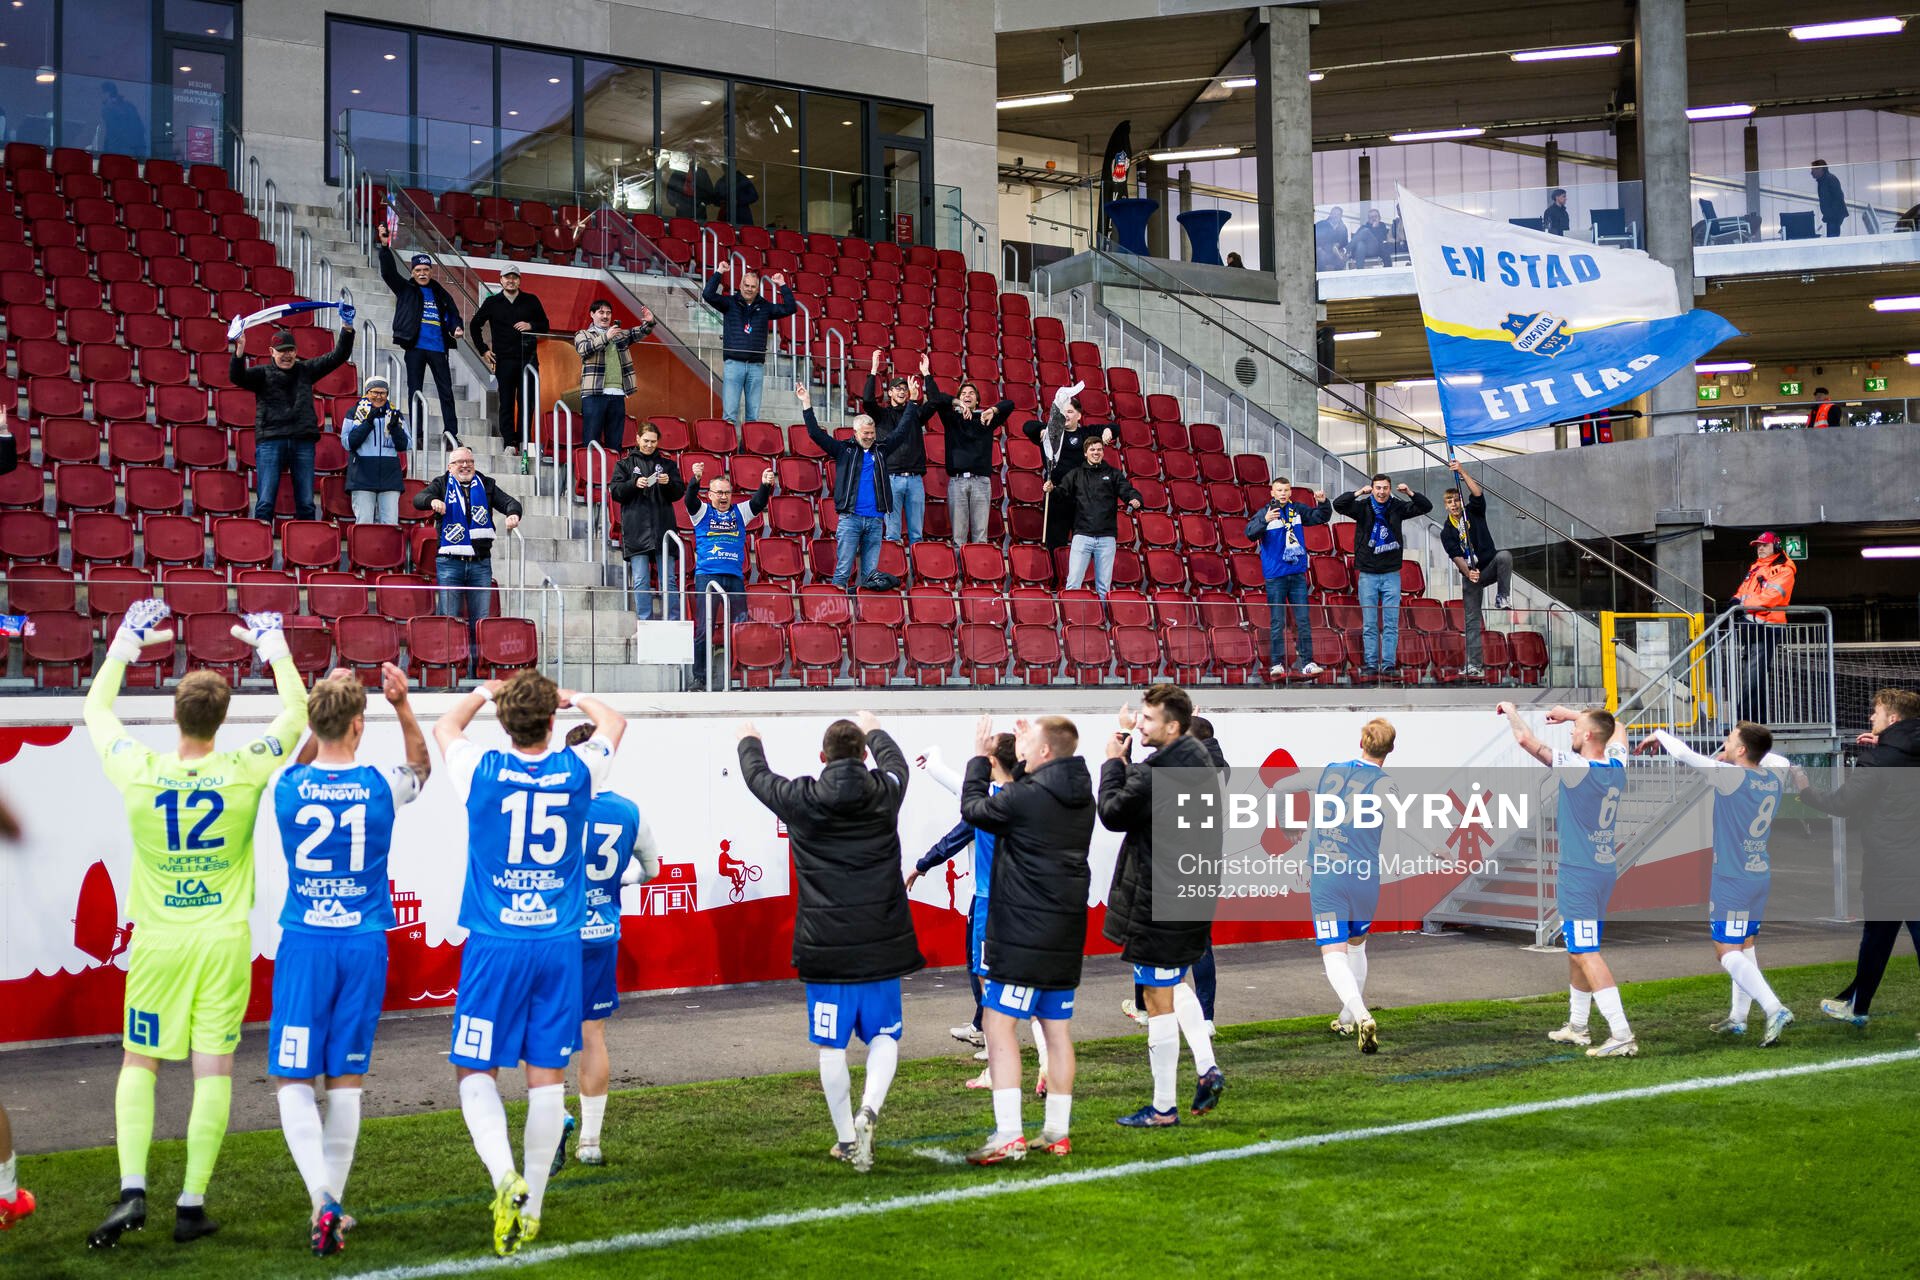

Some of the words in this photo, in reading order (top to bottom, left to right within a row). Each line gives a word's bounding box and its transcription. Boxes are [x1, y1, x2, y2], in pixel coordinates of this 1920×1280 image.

[1441, 245, 1486, 282] EN
[1497, 251, 1602, 289] STAD
[1480, 378, 1560, 421] ETT
[311, 788, 370, 800] PINGVIN
[1599, 786, 1620, 829] 6
[154, 789, 225, 851] 12
[1749, 795, 1776, 838] 8
[501, 791, 570, 865] 15
[295, 804, 366, 872] 21
[158, 860, 230, 872] WELLNESS
[168, 855, 218, 864] NORDIC
[504, 868, 556, 879] NORDIC
[176, 879, 209, 895] ICA
[305, 877, 355, 887] NORDIC
[492, 875, 564, 890] WELLNESS
[296, 884, 367, 897] WELLNESS
[167, 895, 220, 906] KVANTUM
[312, 899, 347, 916] ICA
[512, 892, 547, 912] ICA
[582, 926, 613, 937] ANTUM
